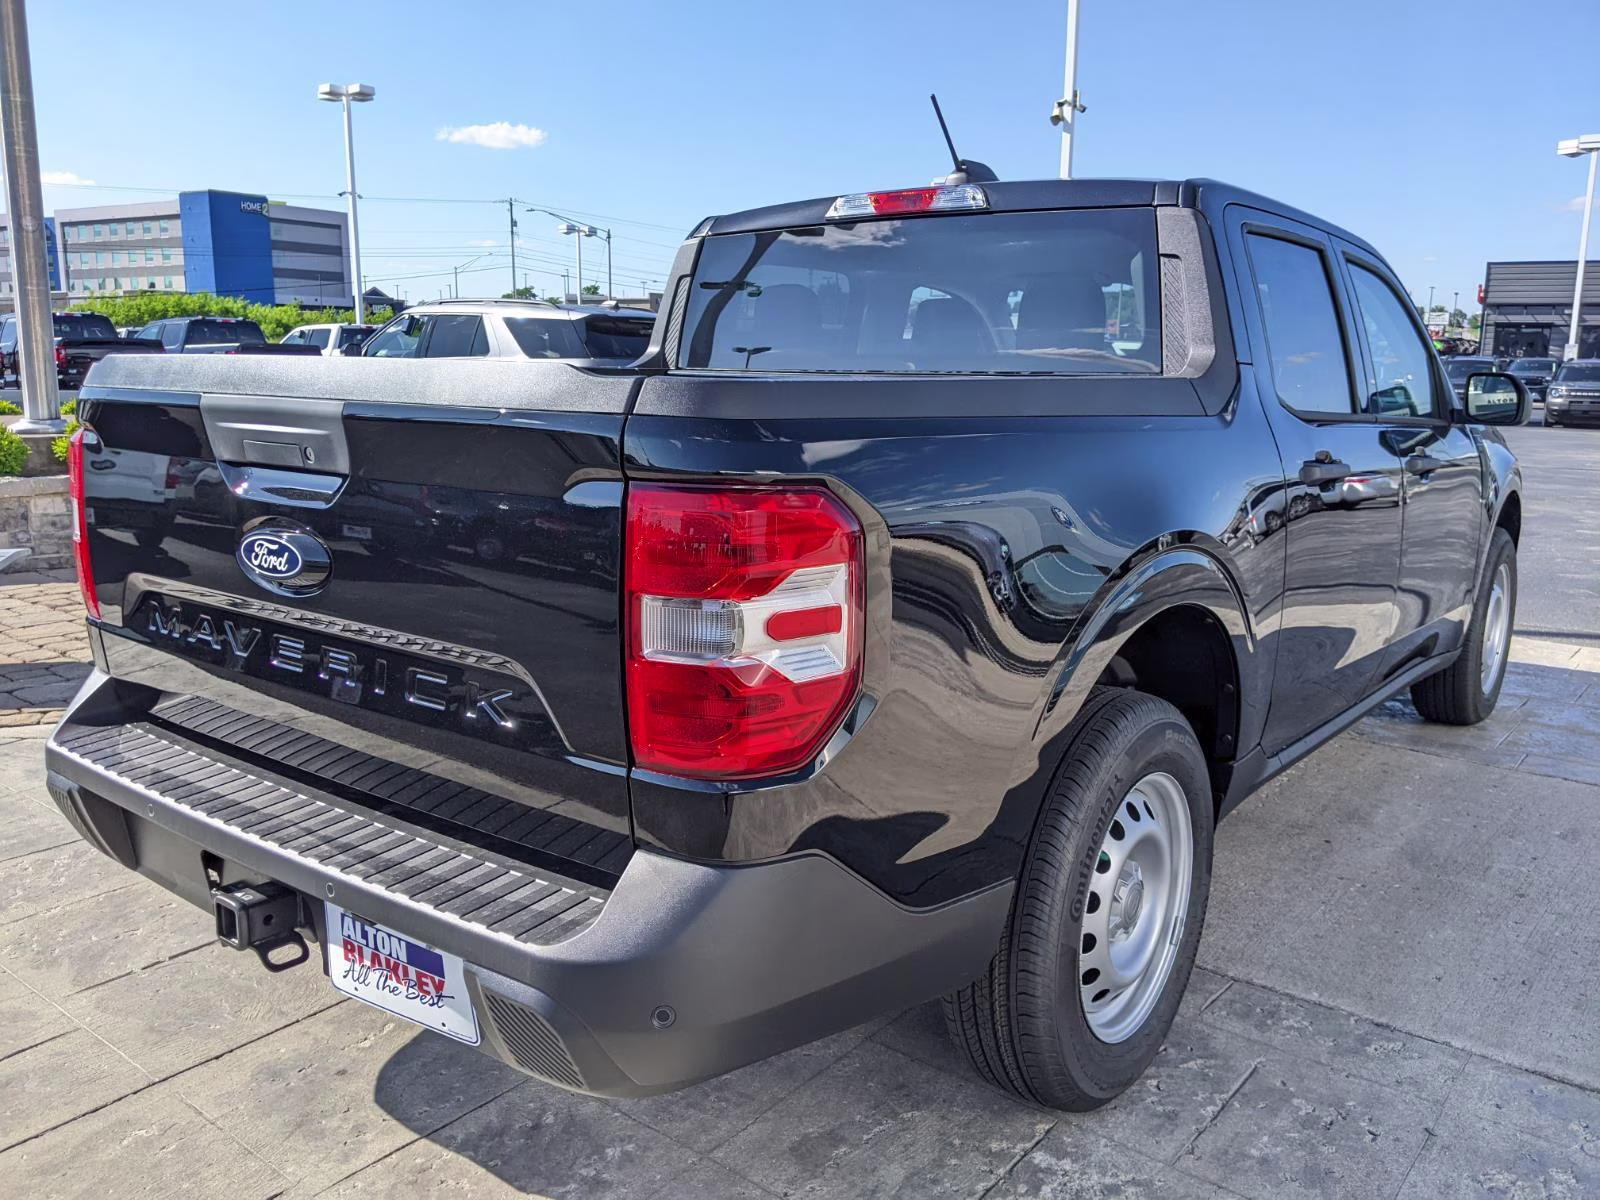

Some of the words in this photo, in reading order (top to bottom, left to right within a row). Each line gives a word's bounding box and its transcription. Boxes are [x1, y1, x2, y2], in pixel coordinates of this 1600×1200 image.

[251, 540, 288, 571] Ford
[148, 600, 513, 729] MAVERICK
[1070, 789, 1117, 923] Continental
[342, 914, 408, 964] ALTON
[342, 937, 446, 997] BLAKLEY
[342, 956, 371, 987] All
[373, 968, 402, 997] The
[402, 977, 455, 1009] Best
